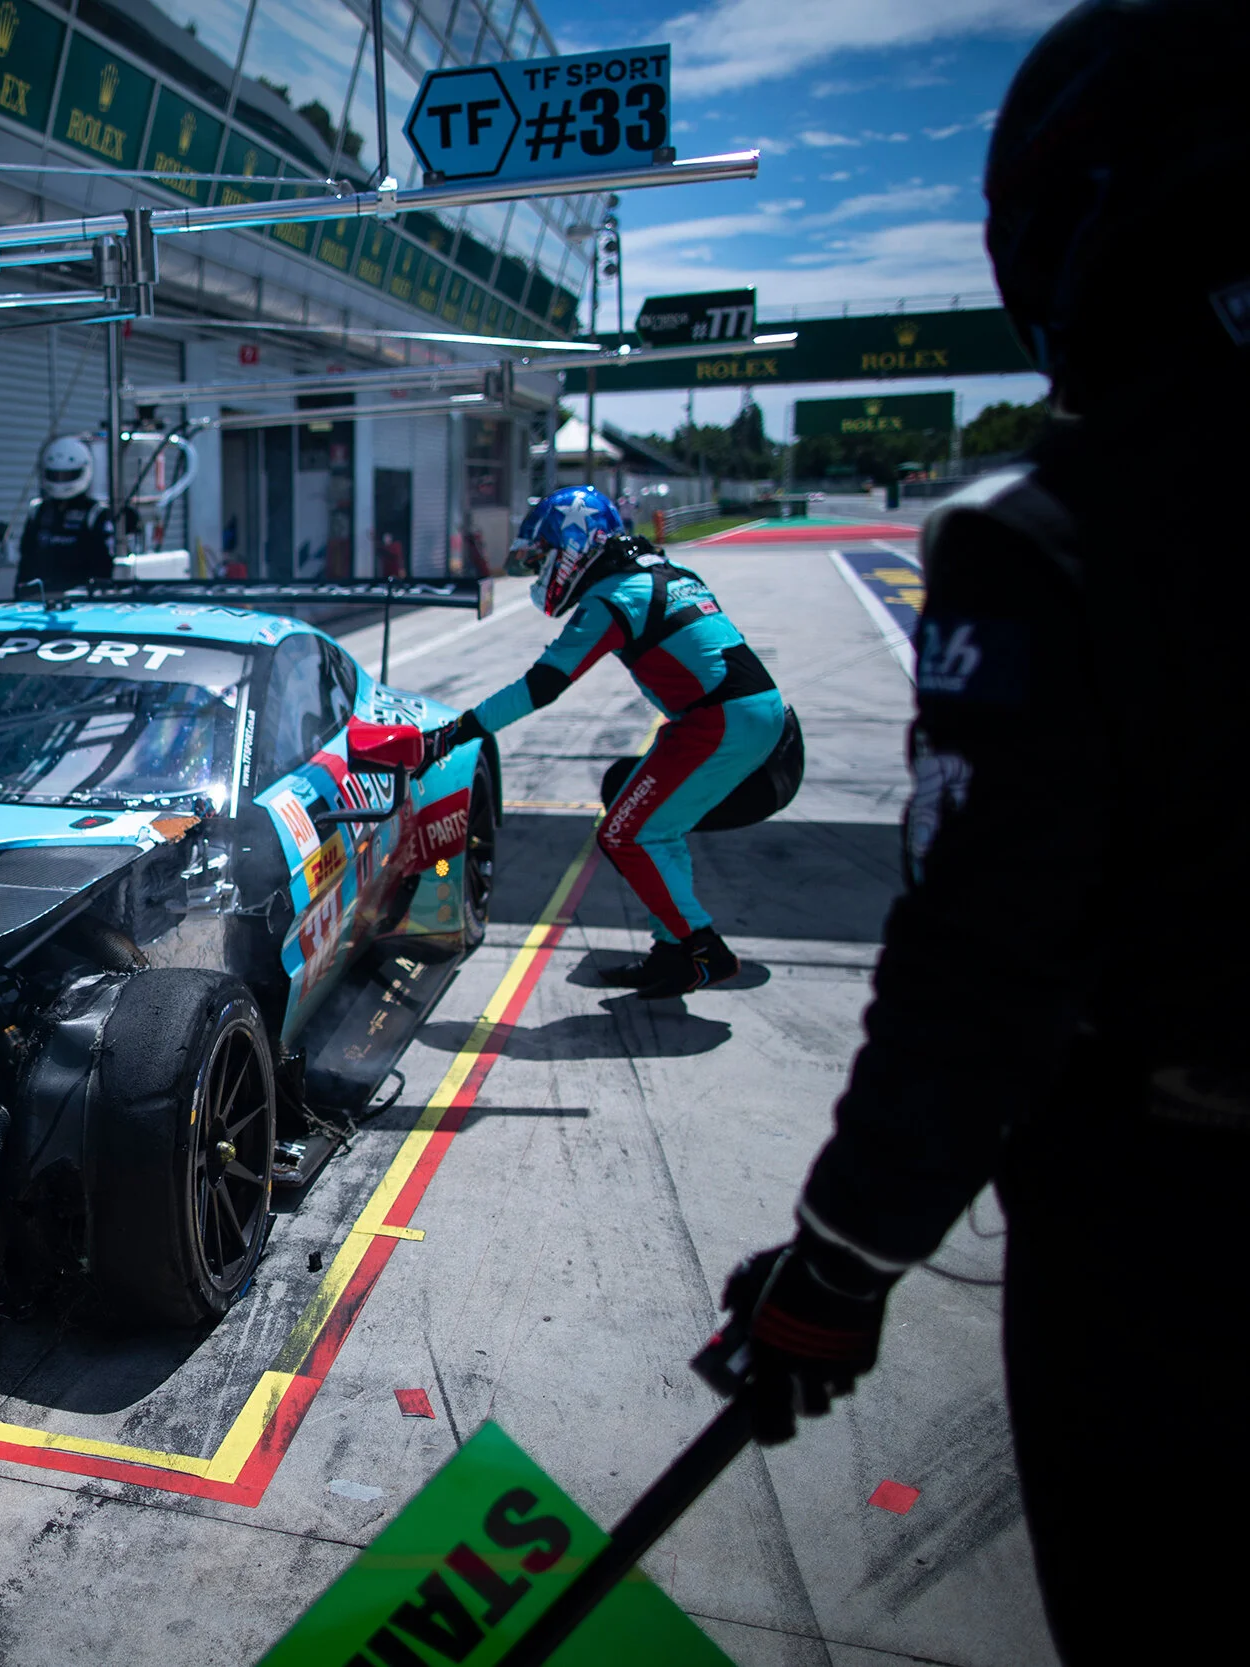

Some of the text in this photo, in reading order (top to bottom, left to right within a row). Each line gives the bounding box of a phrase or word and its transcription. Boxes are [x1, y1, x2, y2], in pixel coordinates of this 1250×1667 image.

[523, 54, 668, 91] TF SPORT
[66, 107, 127, 162] ROLEX
[427, 98, 501, 149] TF
[525, 82, 667, 162] #33
[696, 358, 778, 380] ROLEX
[861, 348, 949, 371] ROLEX
[842, 415, 904, 433] ROLEX
[426, 808, 469, 851] PARTS
[310, 844, 342, 887] DHL
